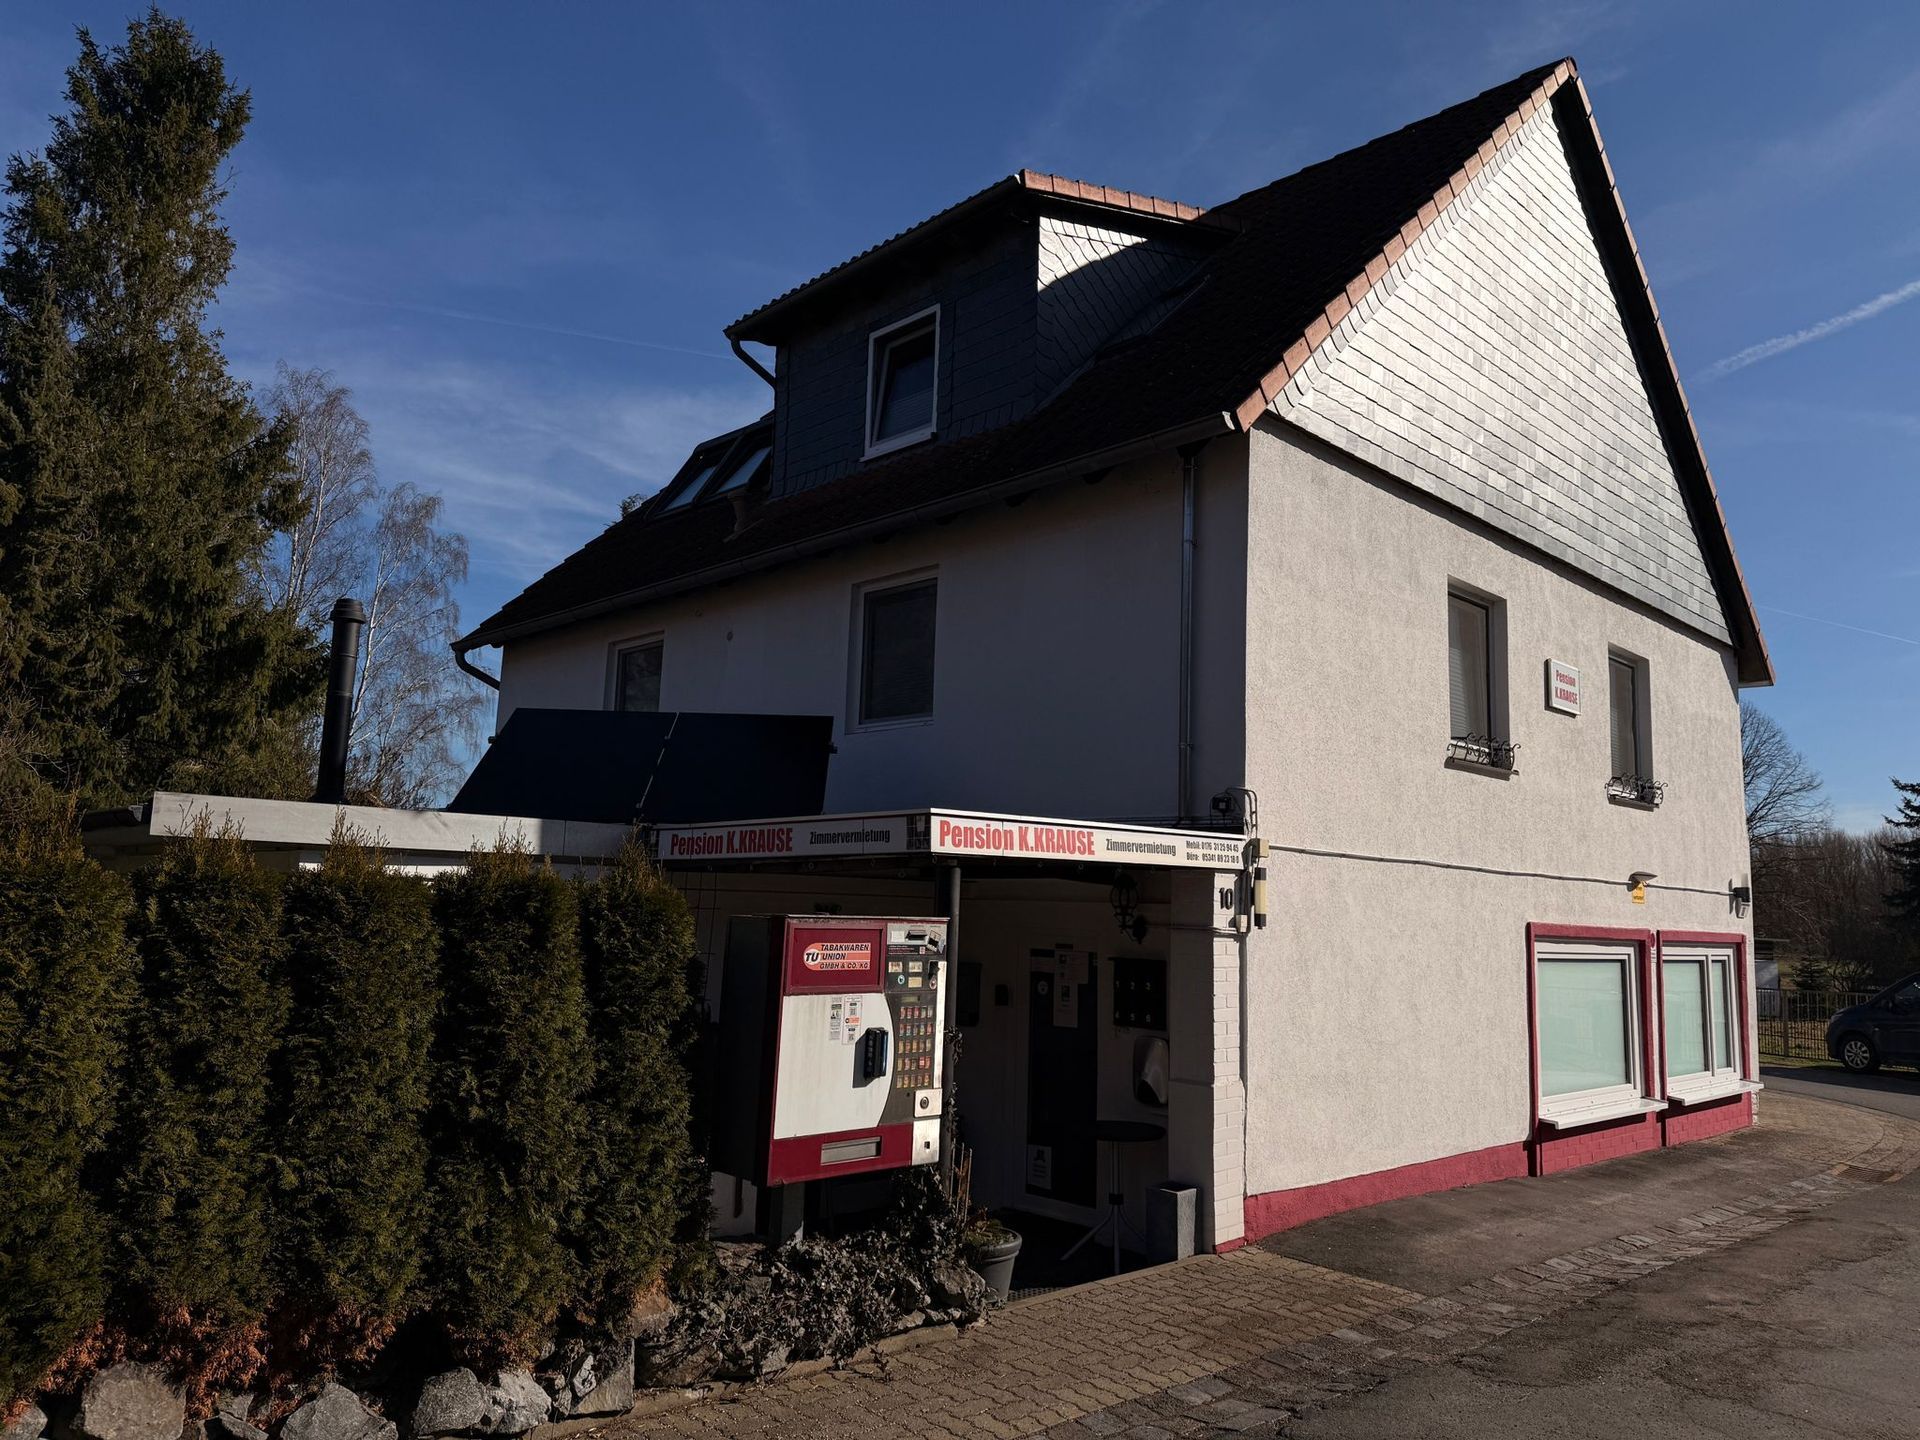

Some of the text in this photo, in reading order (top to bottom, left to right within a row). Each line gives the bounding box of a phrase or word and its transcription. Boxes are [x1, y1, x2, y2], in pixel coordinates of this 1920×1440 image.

[671, 828, 890, 855] Pension K.KRAUSE Zimmervermietung
[939, 820, 1176, 856] Pension K.KRAUSE Zimmervermietung
[1219, 887, 1233, 910] 10
[805, 952, 819, 962] TU
